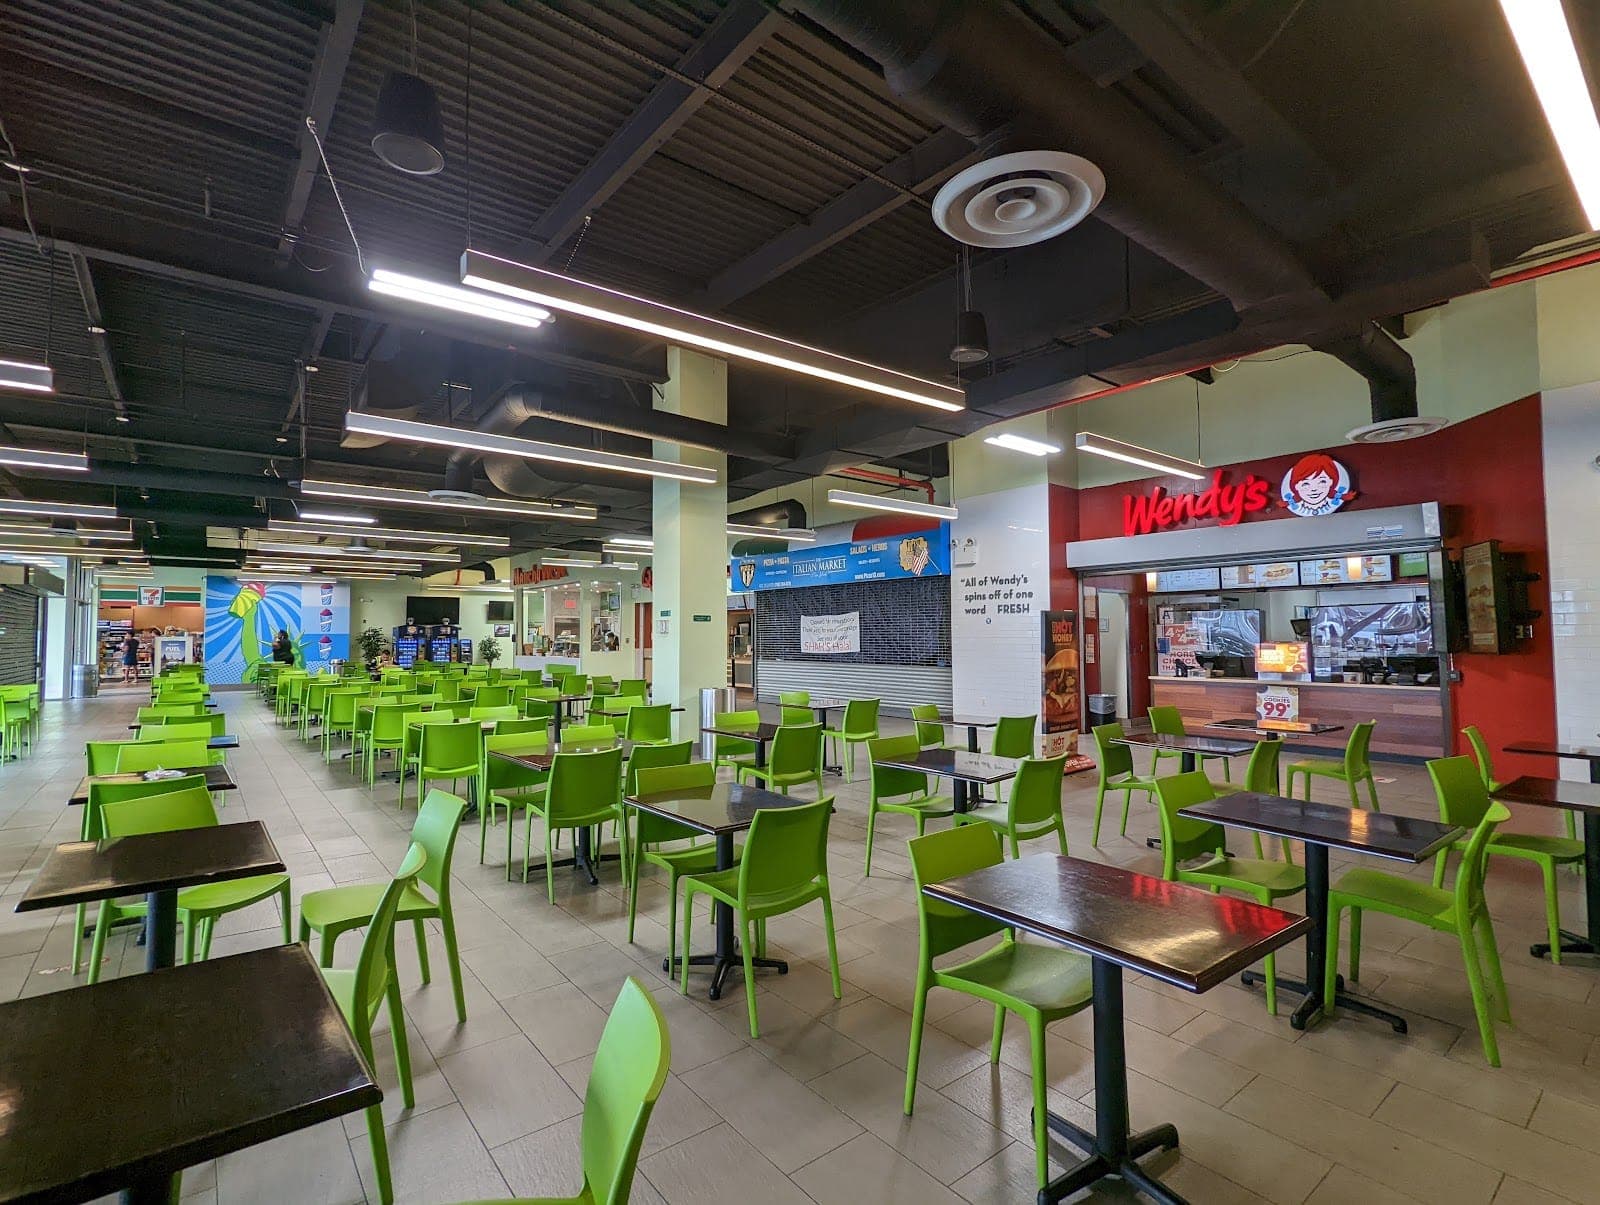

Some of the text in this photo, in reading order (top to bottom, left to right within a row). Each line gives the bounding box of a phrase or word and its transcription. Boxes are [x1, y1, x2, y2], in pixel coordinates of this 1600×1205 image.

[1123, 469, 1269, 537] Wendy's
[792, 562, 817, 575] ITALIAN
[818, 558, 847, 571] MARKET
[978, 576, 988, 586] of
[990, 574, 1028, 587] Wendy's
[964, 589, 1034, 603] spins off of one
[964, 603, 1030, 615] word FRESH
[1162, 611, 1171, 620] A
[1165, 627, 1175, 638] 4
